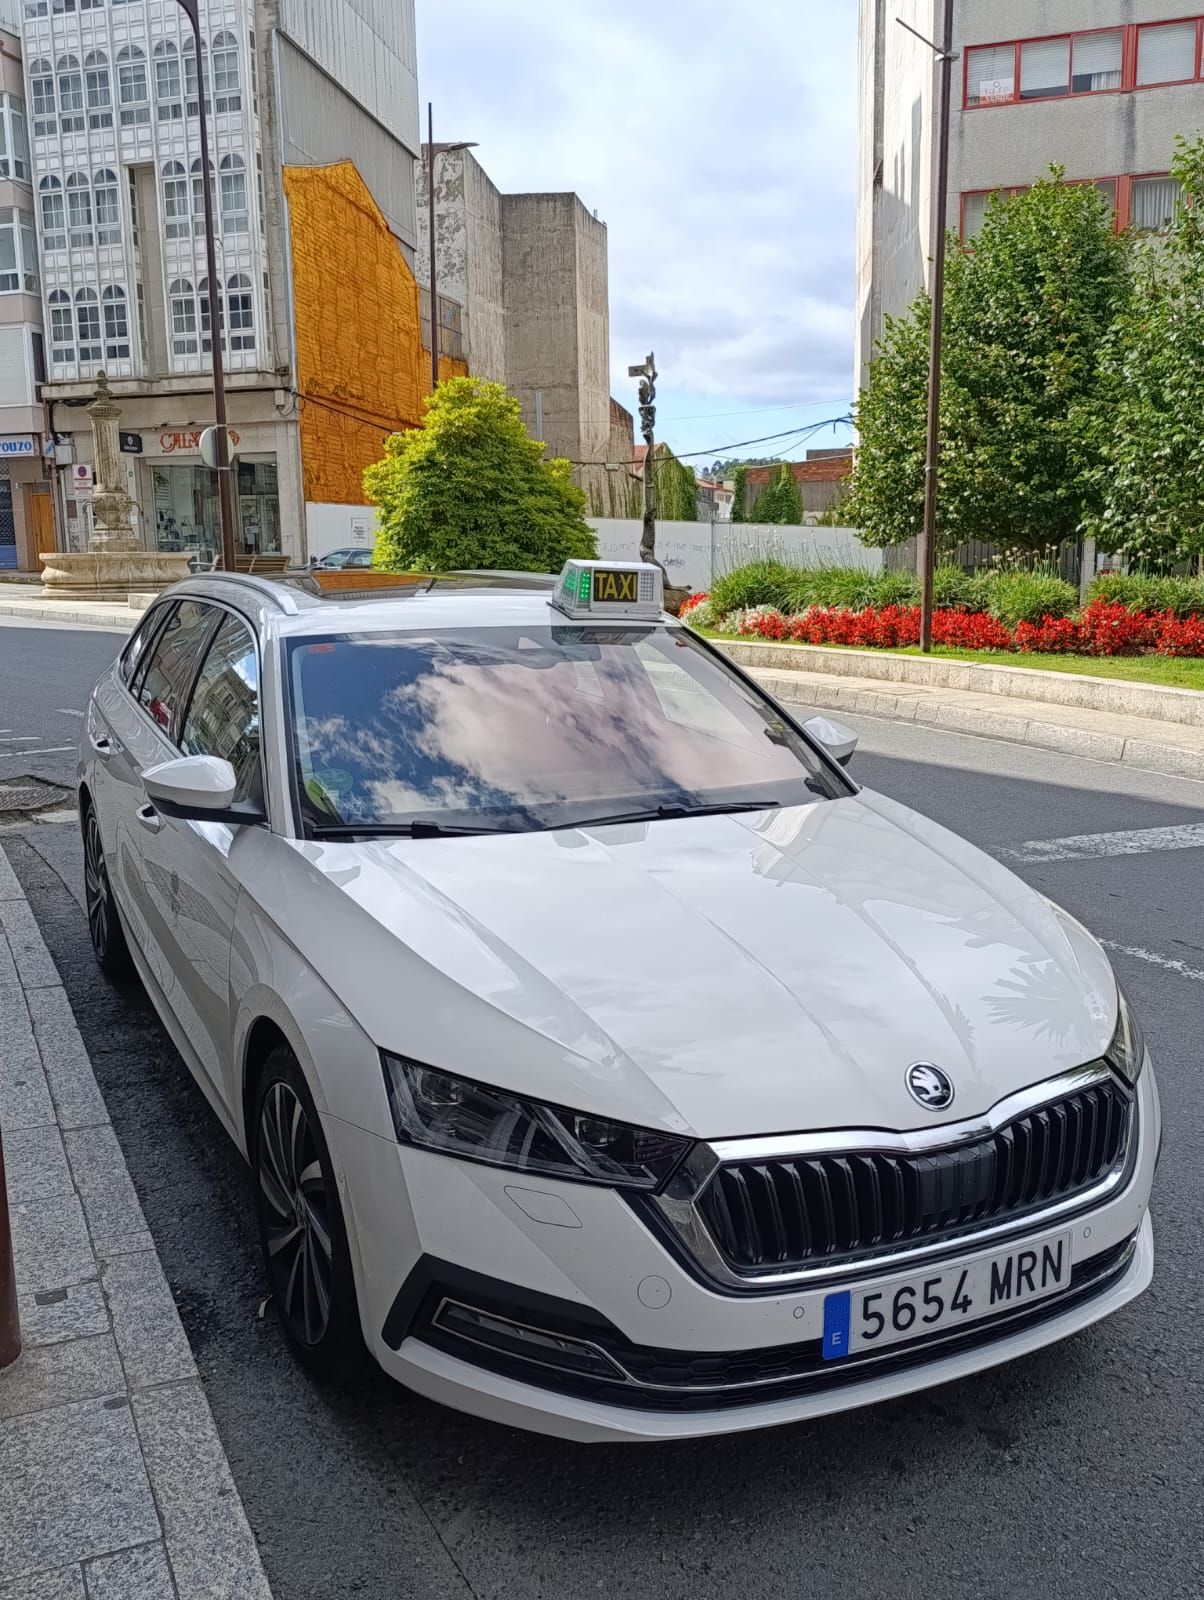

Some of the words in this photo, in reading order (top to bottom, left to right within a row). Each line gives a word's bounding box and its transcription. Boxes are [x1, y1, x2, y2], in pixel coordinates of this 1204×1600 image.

[0, 441, 32, 452] OUZO
[595, 572, 637, 600] TAXI
[861, 1269, 972, 1340] 5654
[989, 1240, 1063, 1305] MRN
[831, 1331, 842, 1345] E
